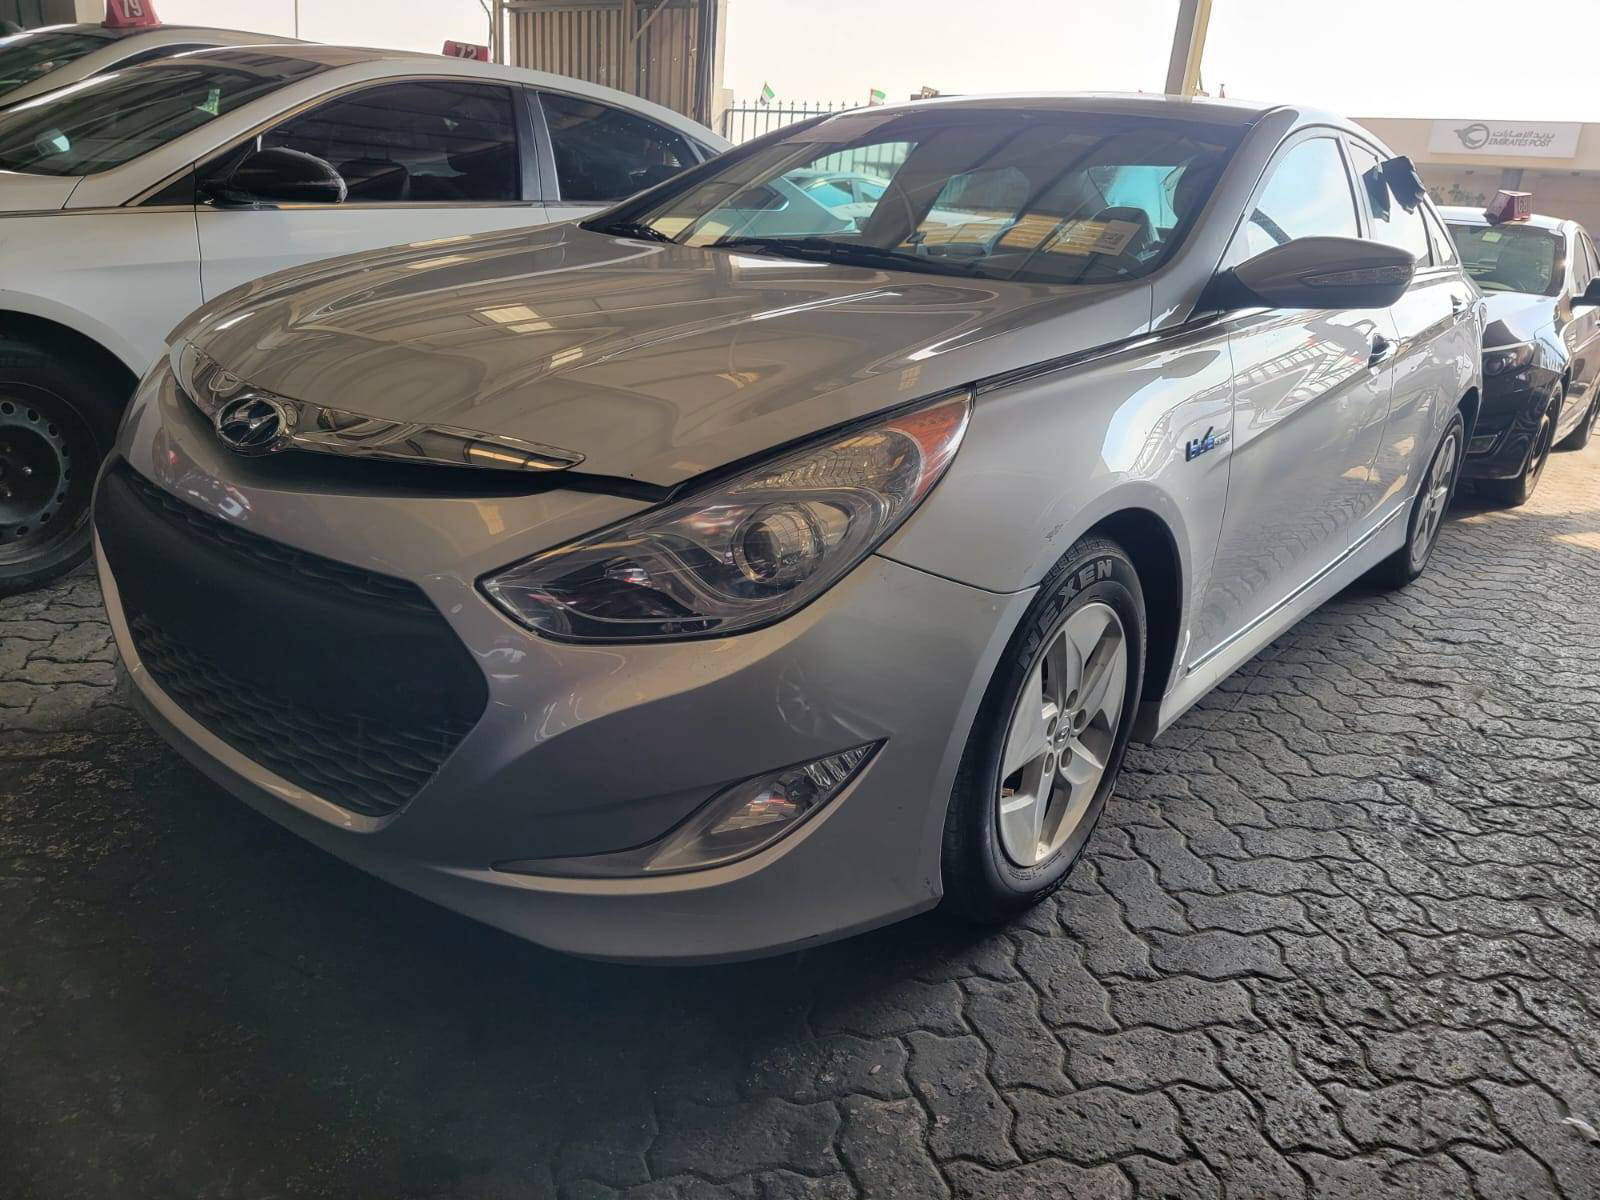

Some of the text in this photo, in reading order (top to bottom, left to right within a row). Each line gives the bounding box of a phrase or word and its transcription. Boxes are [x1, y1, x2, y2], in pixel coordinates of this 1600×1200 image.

[1488, 137, 1552, 147] EMIRATES POST
[1016, 559, 1113, 672] NEXEN
